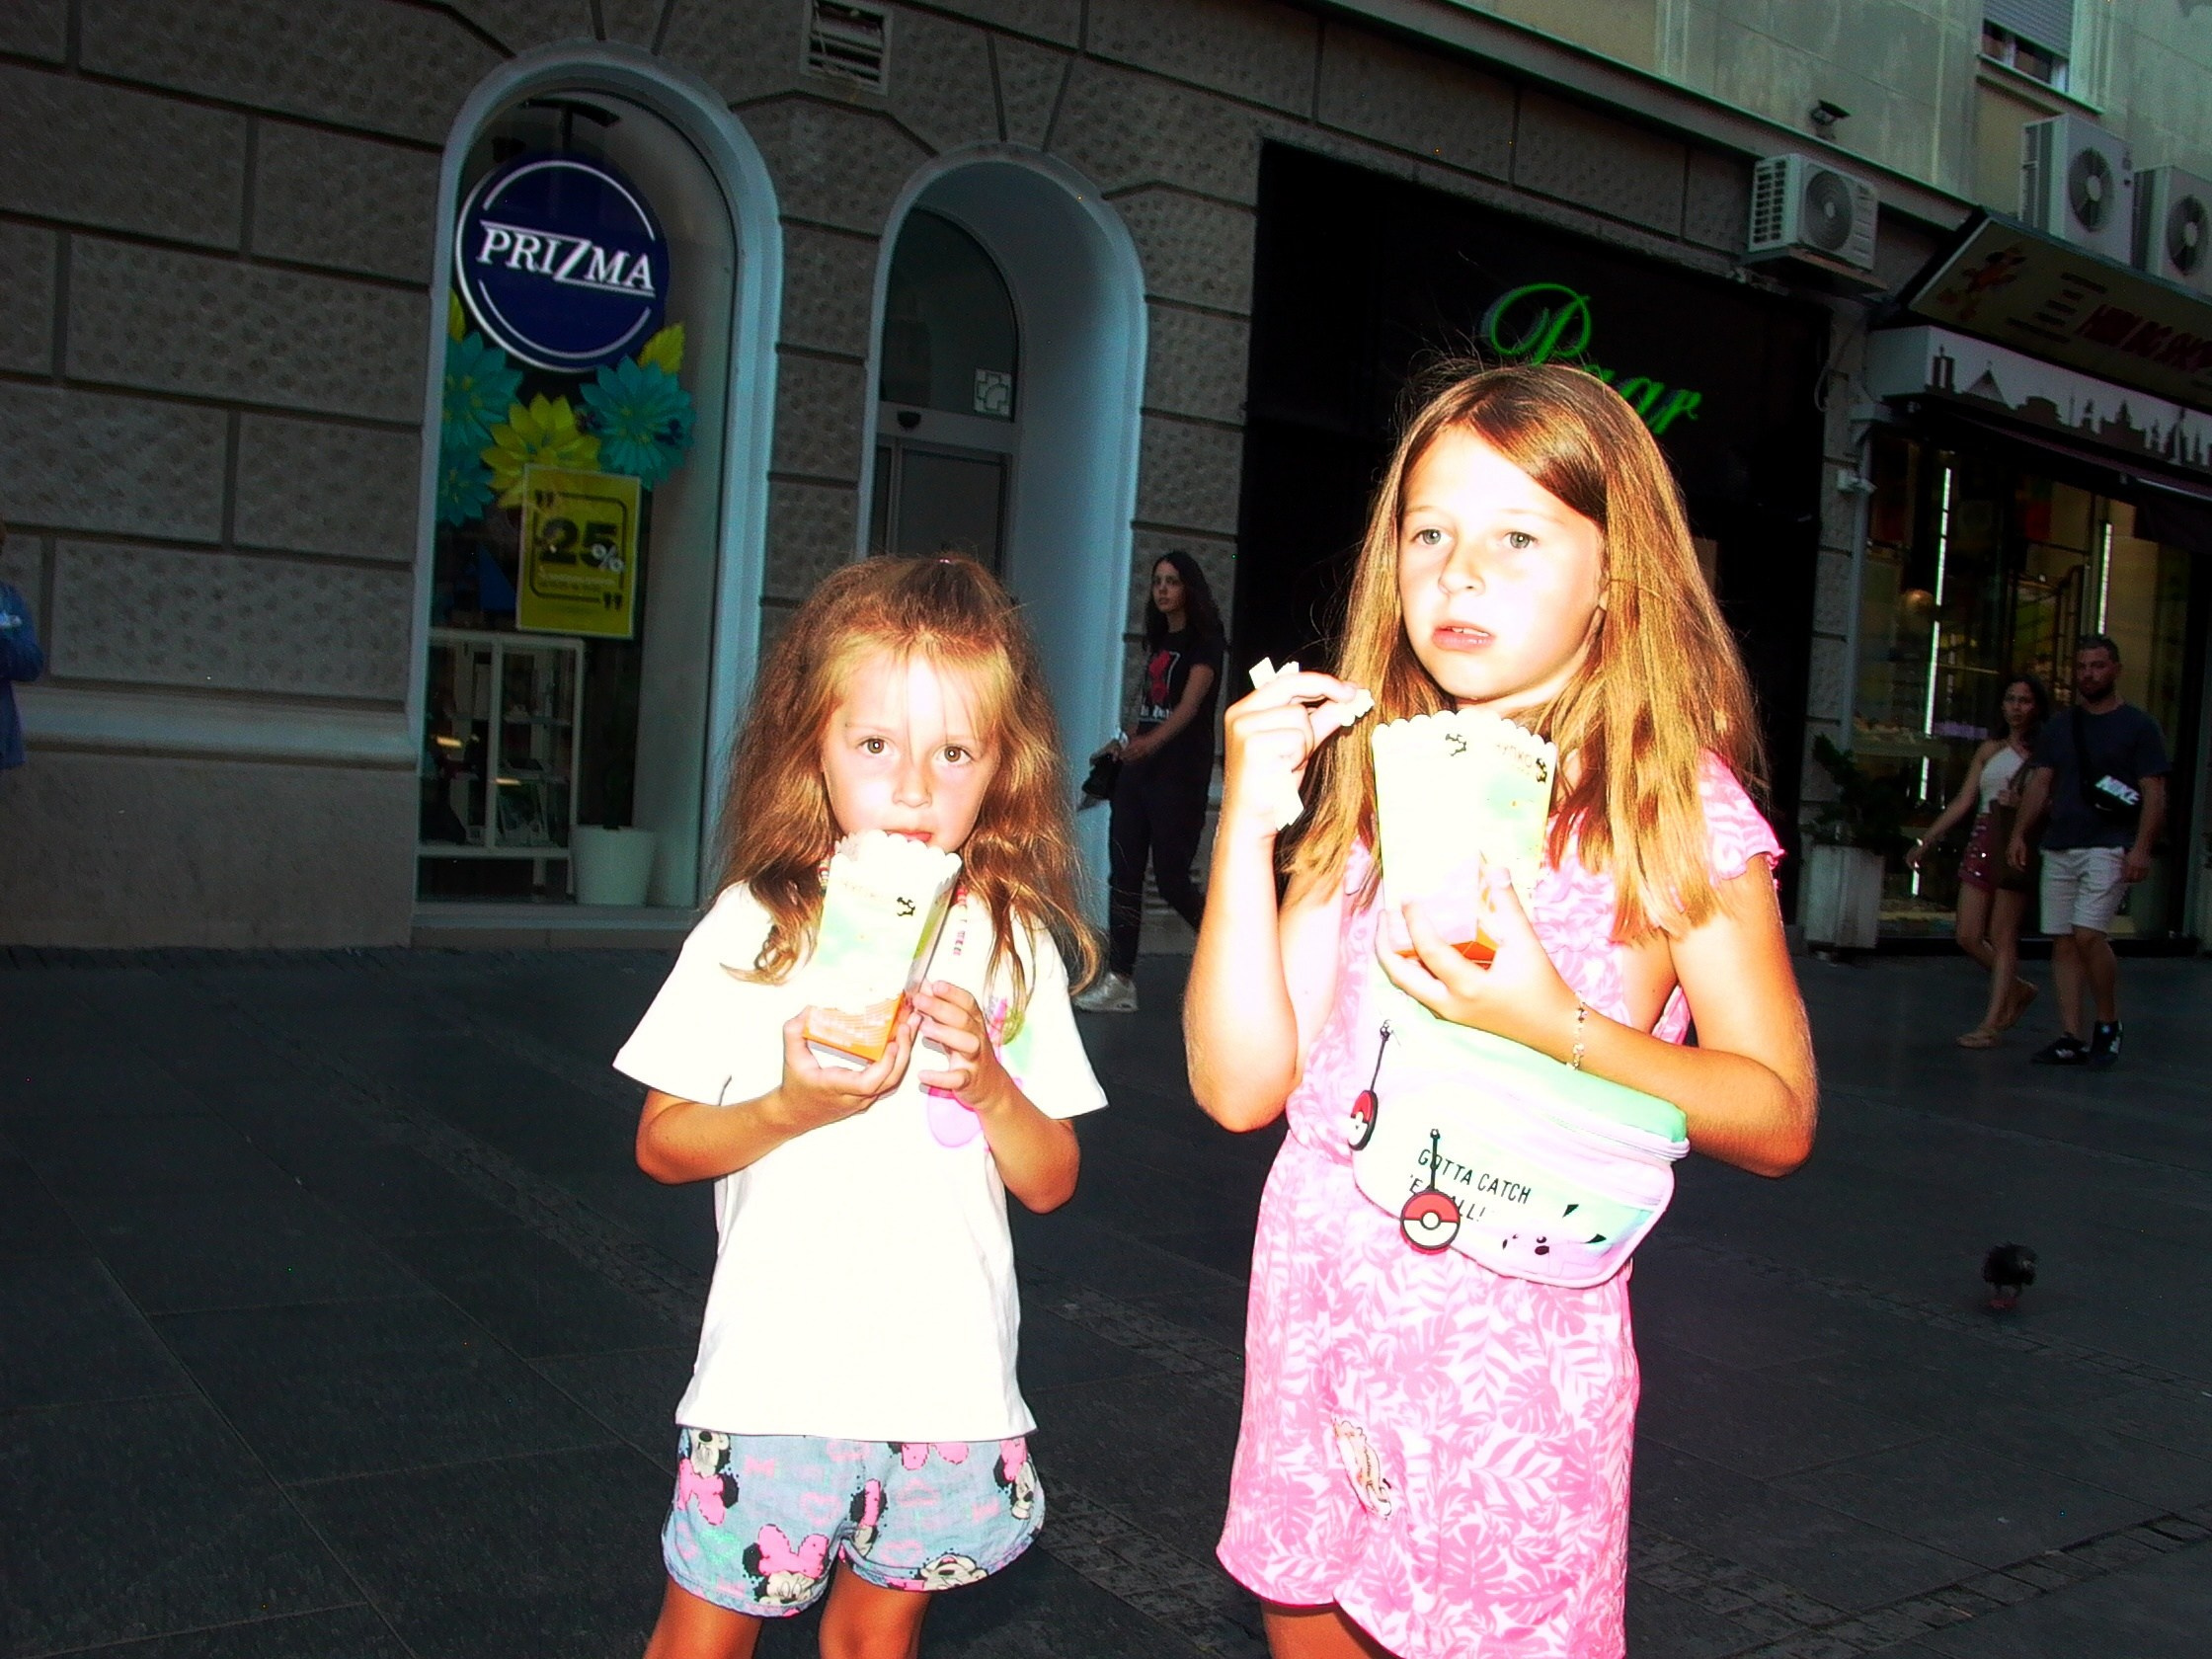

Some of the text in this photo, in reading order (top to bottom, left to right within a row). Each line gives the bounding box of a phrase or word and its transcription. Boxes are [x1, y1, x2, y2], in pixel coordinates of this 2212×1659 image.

[475, 219, 656, 300] PRIZMA
[2094, 774, 2142, 807] NIKE
[1417, 1148, 1532, 1205] GOTTA CATCH
